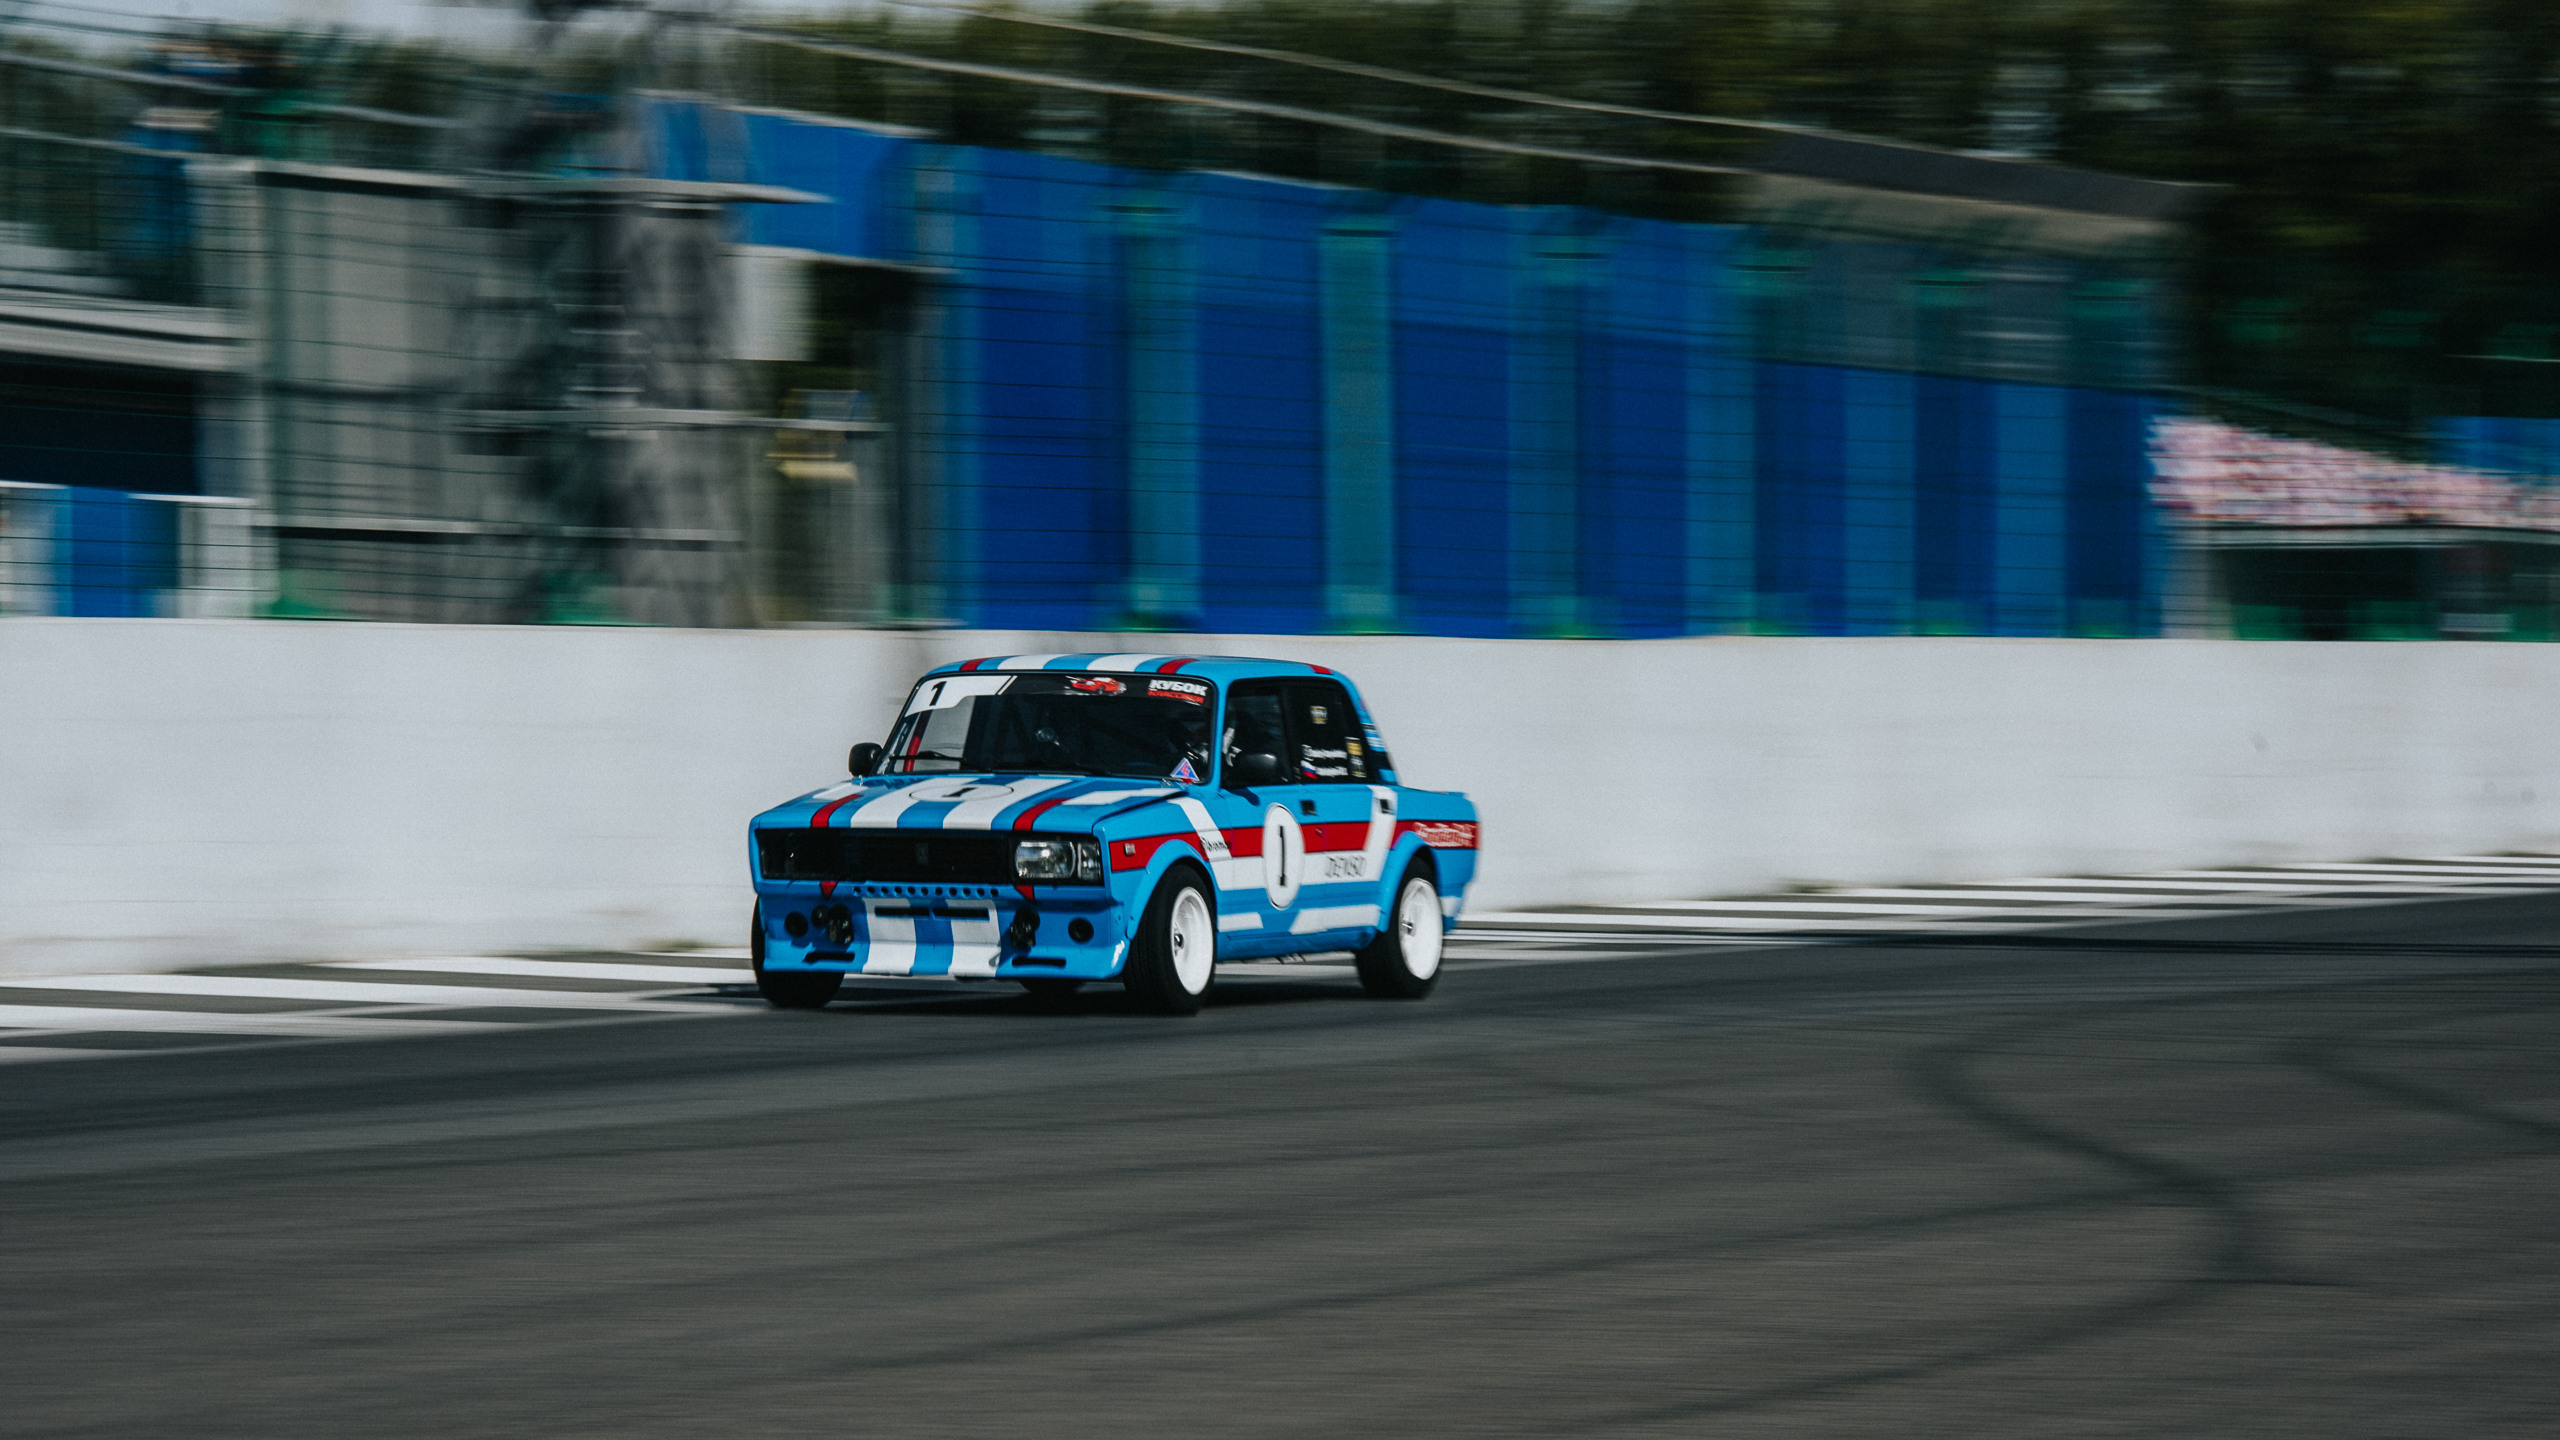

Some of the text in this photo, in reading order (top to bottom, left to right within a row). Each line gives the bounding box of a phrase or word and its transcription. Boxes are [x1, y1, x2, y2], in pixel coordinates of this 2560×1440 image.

[929, 681, 947, 706] 1
[1149, 680, 1208, 696] КУБОК
[942, 787, 977, 798] 1
[1278, 825, 1287, 887] 1
